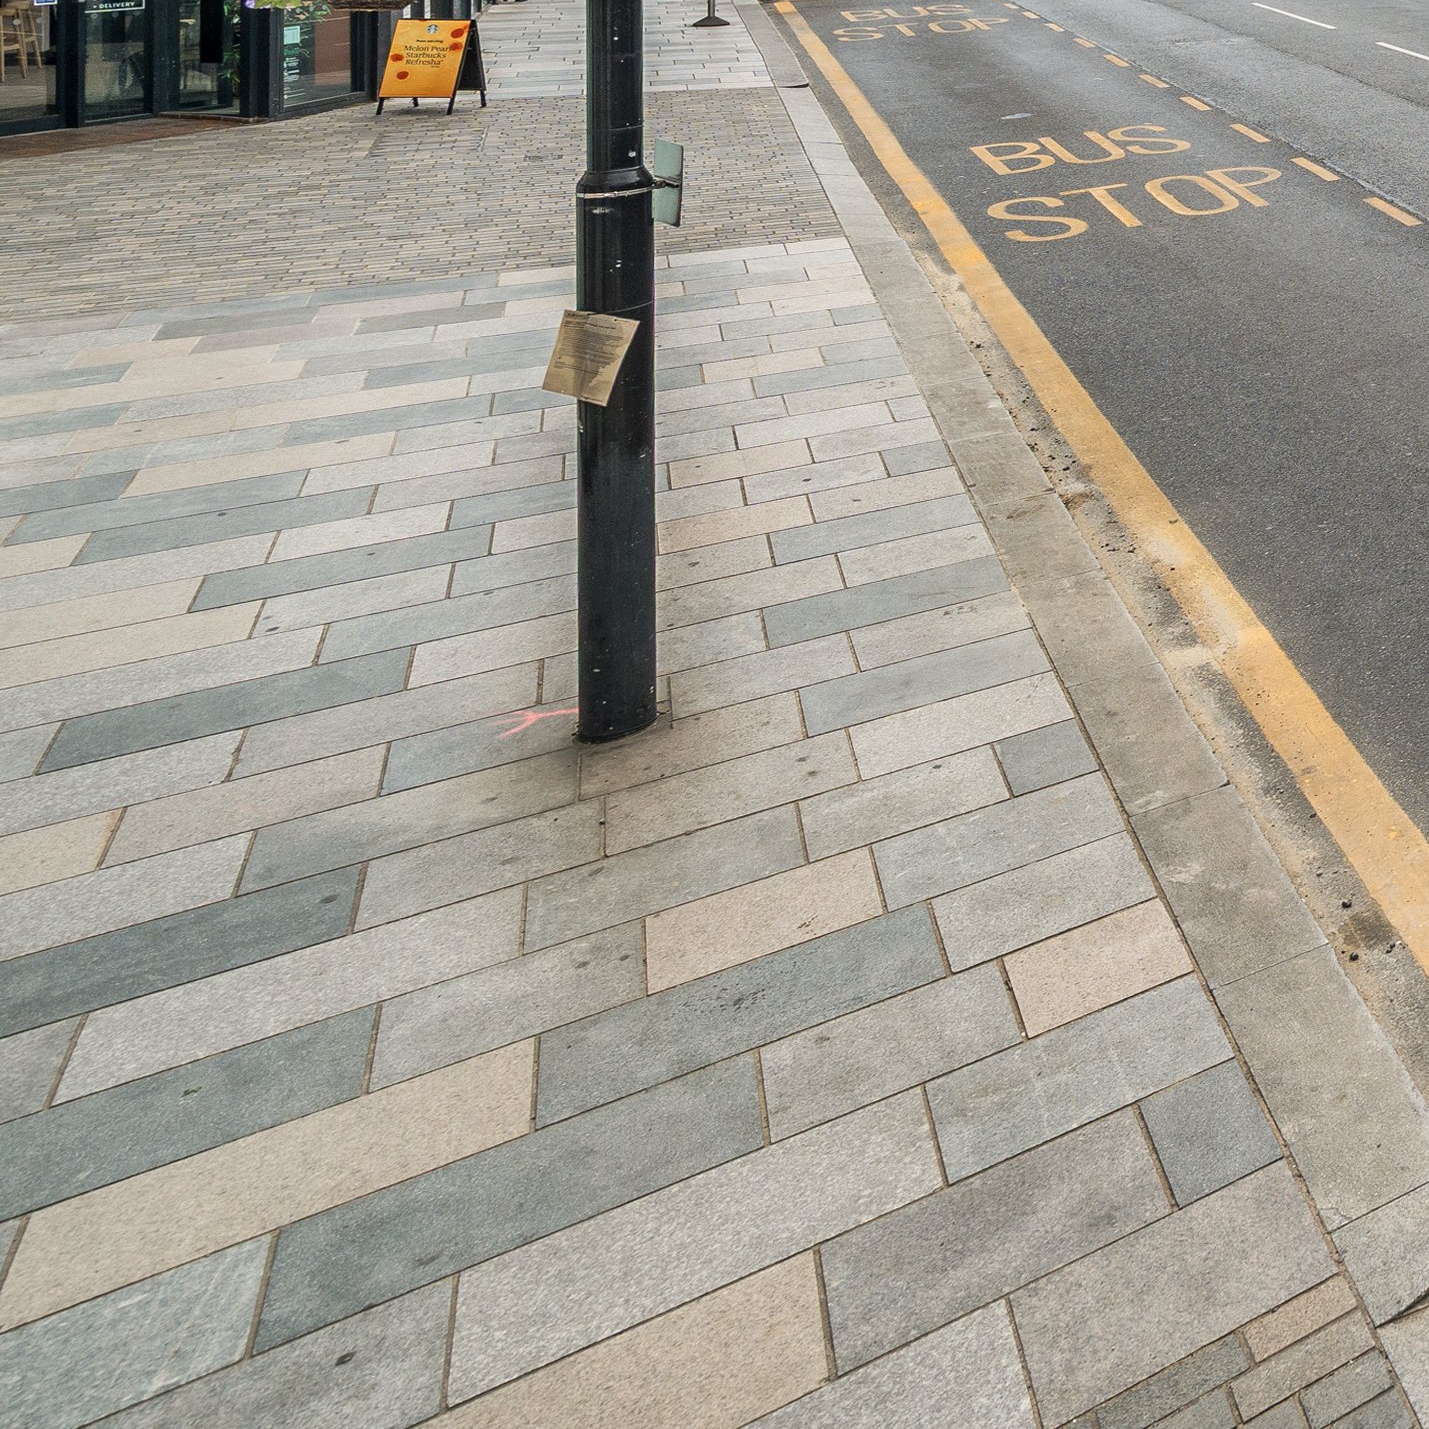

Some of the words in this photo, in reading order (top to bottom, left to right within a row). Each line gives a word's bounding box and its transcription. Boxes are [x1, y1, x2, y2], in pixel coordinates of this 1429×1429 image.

[99, 1, 135, 9] DELIVERY
[840, 4, 973, 21] BUS
[832, 17, 1009, 42] STOP
[969, 122, 1192, 175] BUS
[986, 166, 1283, 242] STOP
